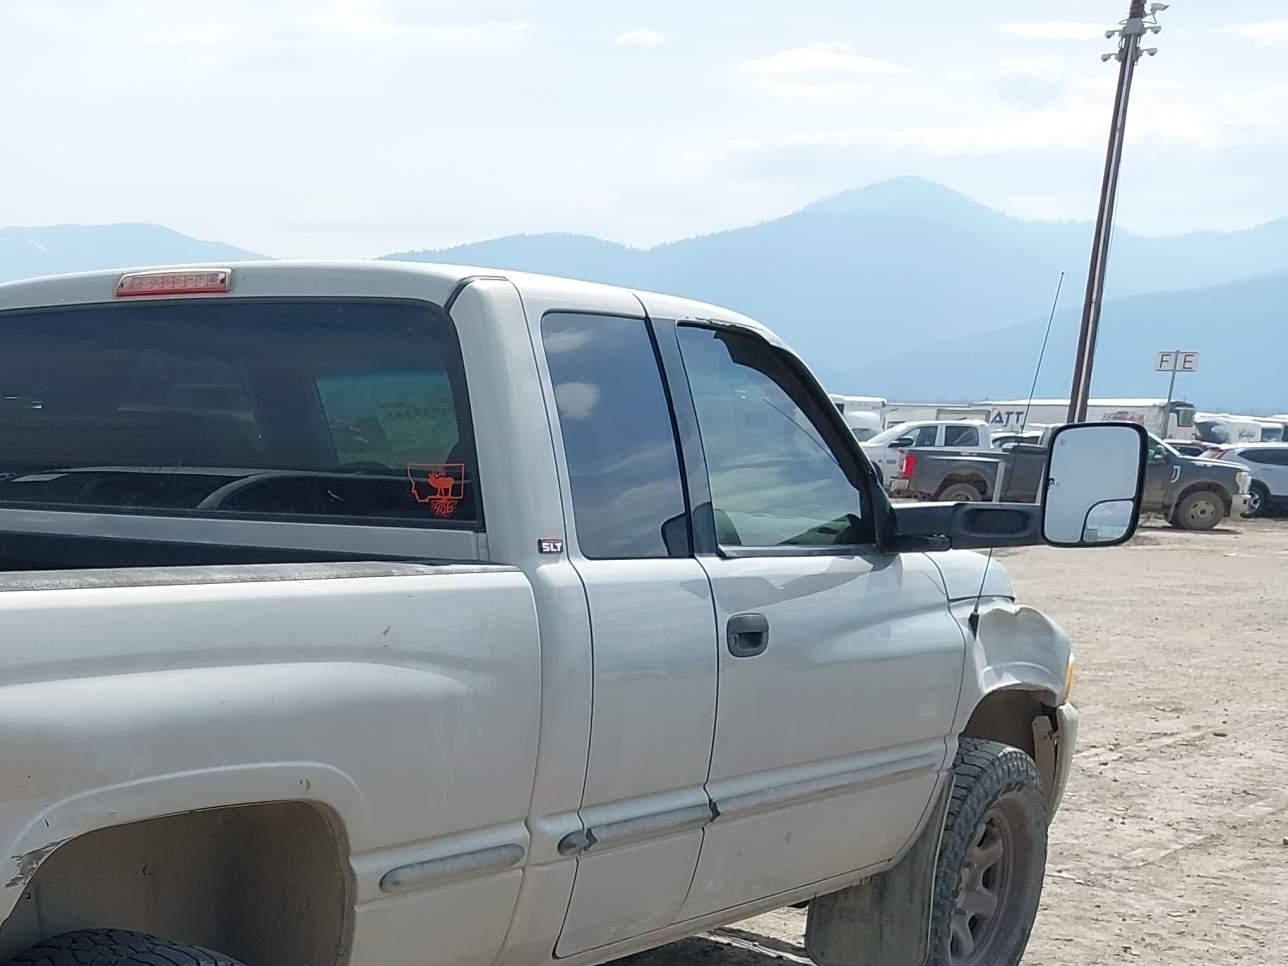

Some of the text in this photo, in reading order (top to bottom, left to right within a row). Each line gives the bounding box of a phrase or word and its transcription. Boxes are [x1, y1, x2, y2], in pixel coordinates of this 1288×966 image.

[1160, 354, 1194, 369] F E
[542, 543, 562, 552] SLT
